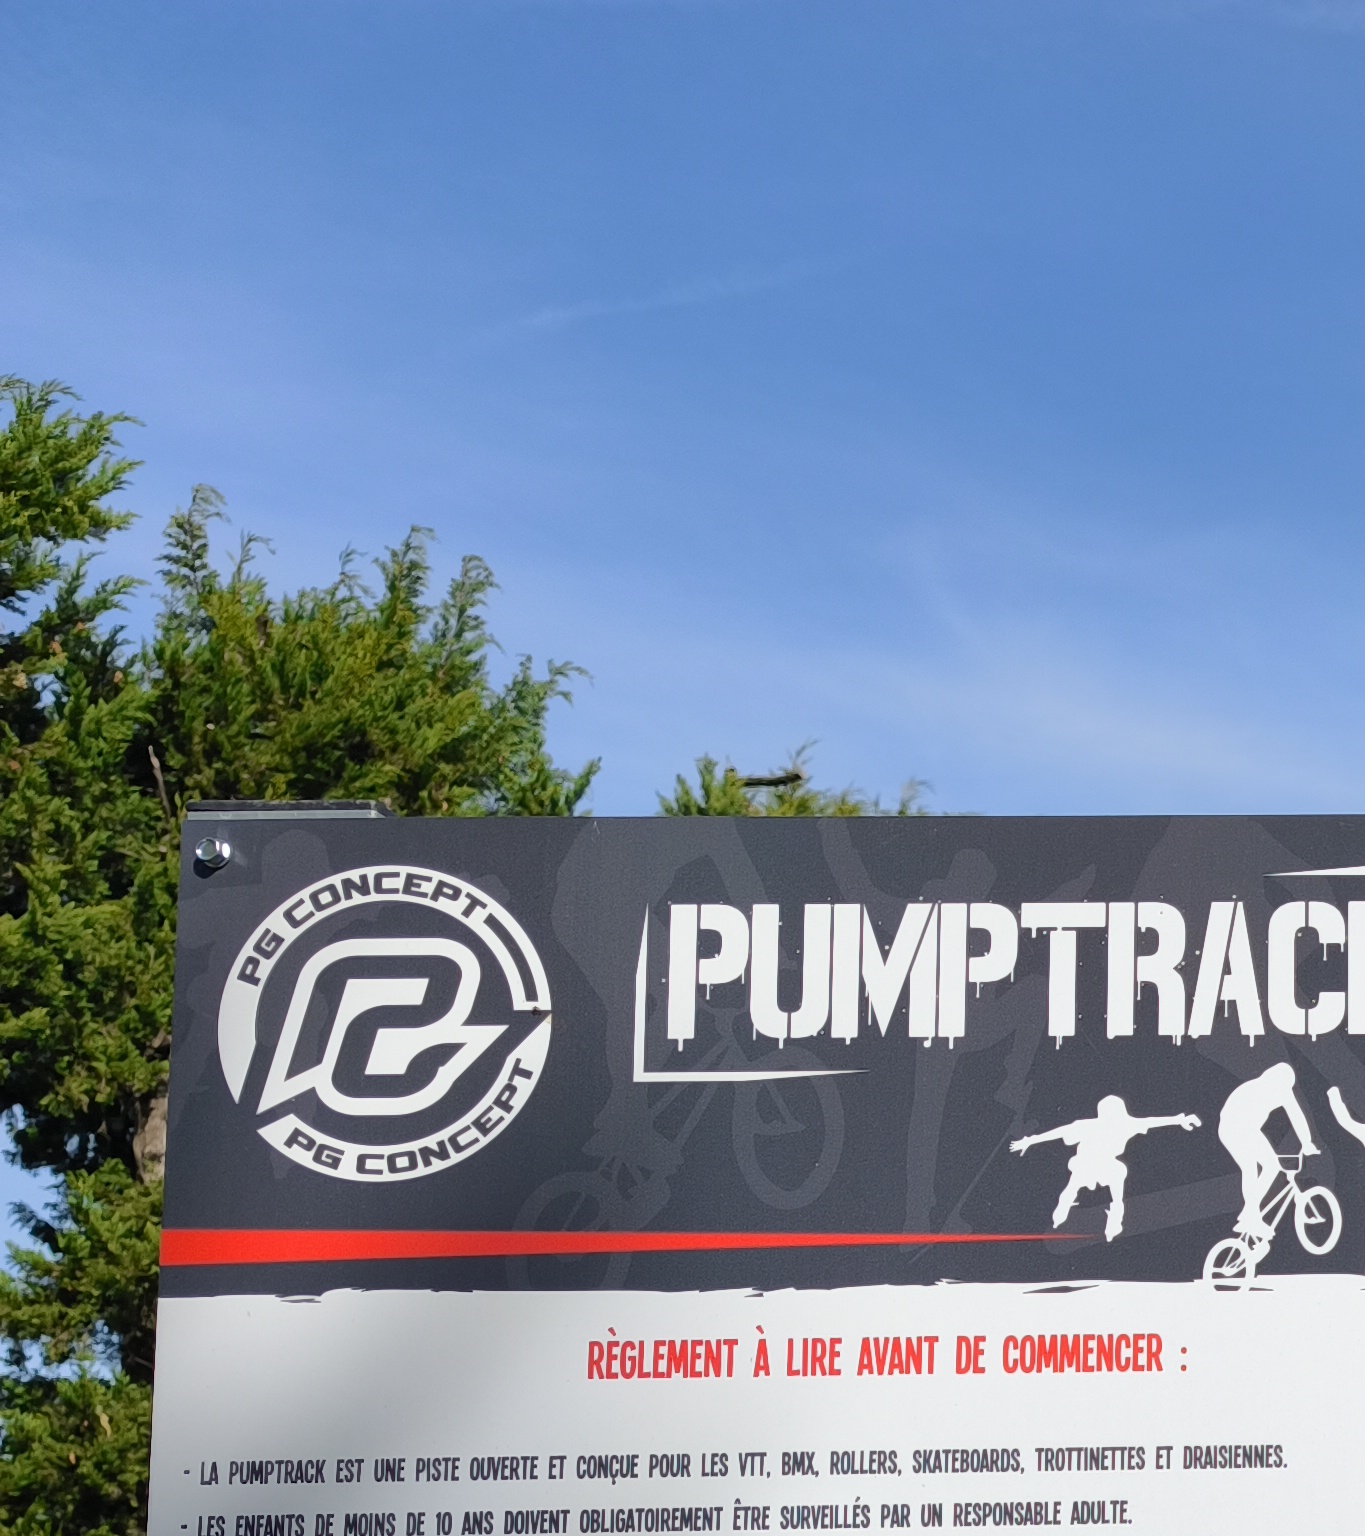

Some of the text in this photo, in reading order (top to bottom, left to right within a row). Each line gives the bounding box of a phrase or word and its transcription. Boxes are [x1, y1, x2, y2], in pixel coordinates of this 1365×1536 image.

[236, 871, 488, 987] PG CONCEPT
[283, 1057, 534, 1176] PG CONCEPT
[587, 1326, 739, 1380] RÈGLEMENT
[752, 1324, 771, 1378] À
[786, 1337, 843, 1378] LIRE
[856, 1335, 940, 1377] AVANT
[955, 1335, 987, 1375] DE
[1002, 1333, 1164, 1374] COMMENCER
[199, 1444, 1288, 1486] LA PUMPTRACK EST UNE PISTE OUVERTE ET CONÇUE POUR LES VTT, BMX, ROLLERS, SKATEBOARDS, TROTTINETTES ET DRAISIENNES.
[405, 1511, 426, 1536] DE
[435, 1511, 453, 1536] 10
[460, 1510, 495, 1536] ANS
[503, 1509, 571, 1535] DOIVENT
[579, 1506, 724, 1534] OBLIGATOIREMENT
[732, 1497, 771, 1531] ÊTRE
[779, 1496, 871, 1530] SURVEILLÉS
[880, 1503, 911, 1529] PAR
[920, 1502, 943, 1528] UN
[953, 1501, 1062, 1528] RESPONSABLE
[1069, 1499, 1133, 1526] ADULTE.
